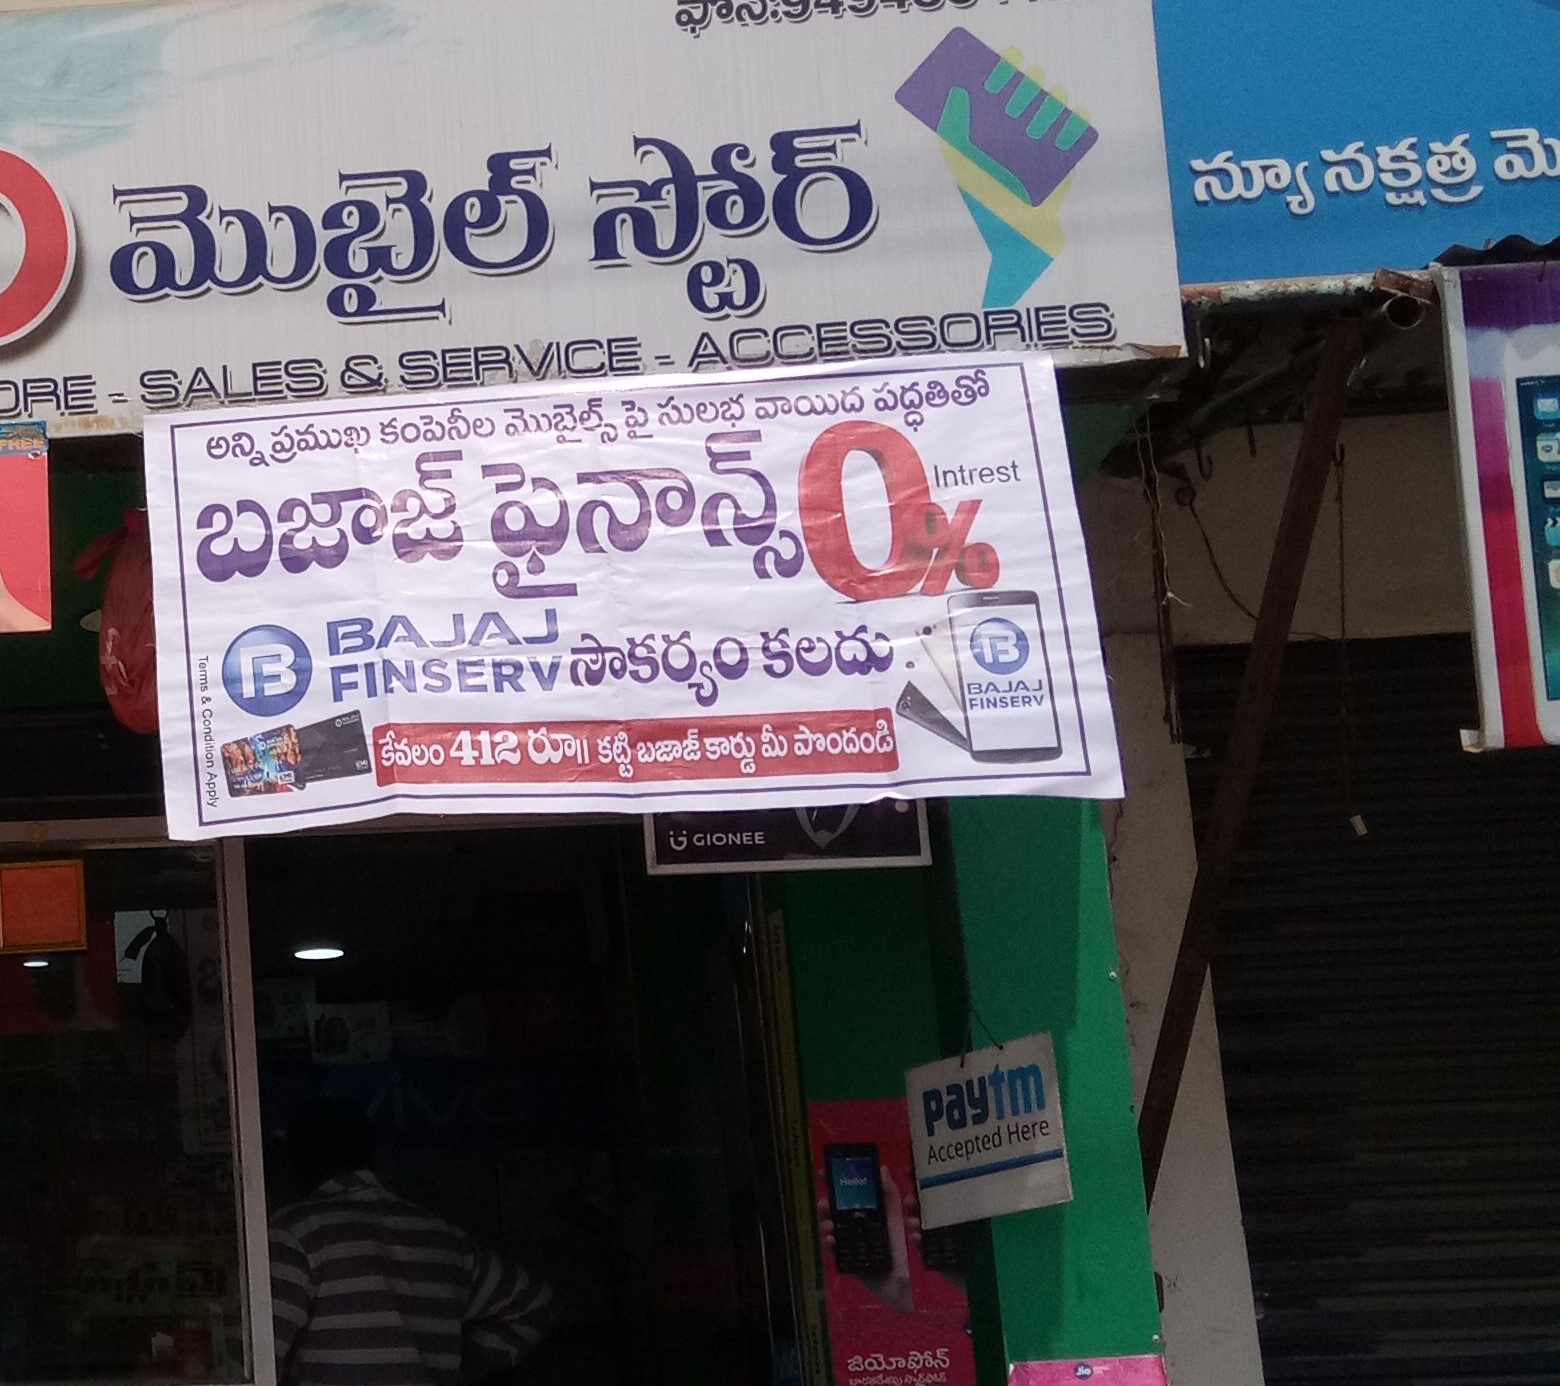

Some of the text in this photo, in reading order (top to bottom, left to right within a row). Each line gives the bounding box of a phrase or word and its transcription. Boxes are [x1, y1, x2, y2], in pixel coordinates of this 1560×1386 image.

[1319, 132, 1485, 209] నక్షత్ర
[108, 143, 556, 321] మొబైల్
[588, 119, 877, 317] స్టోర్
[139, 357, 328, 409] SALES
[340, 353, 386, 393] &
[397, 335, 641, 391] SERVICE
[686, 301, 1116, 371] ACCESSORIES
[206, 428, 270, 467] అన్ని
[269, 423, 371, 464] ప్రముఖ
[379, 408, 496, 445] కంపెనీల
[621, 398, 653, 439] పై
[658, 393, 746, 428] సులభ
[933, 460, 1022, 489] Intrest
[195, 429, 806, 599] బజాజ్ ఫైనాన్స్
[797, 419, 1001, 604] 0%
[326, 608, 561, 657] BAJAJ
[760, 623, 896, 680] కలదు
[328, 654, 563, 703] FINSERV
[966, 678, 1044, 696] BAJAJ
[968, 694, 1045, 711] FINSERV
[198, 655, 218, 808] Terms Condition Apply
[378, 727, 446, 767] కేవలం
[449, 726, 521, 766] 412
[635, 728, 703, 763] బజాజ్
[760, 723, 789, 757] మీ
[792, 719, 894, 756] పొందండి
[691, 829, 766, 848] GIONEE
[926, 1116, 1051, 1166] Accepted Here
